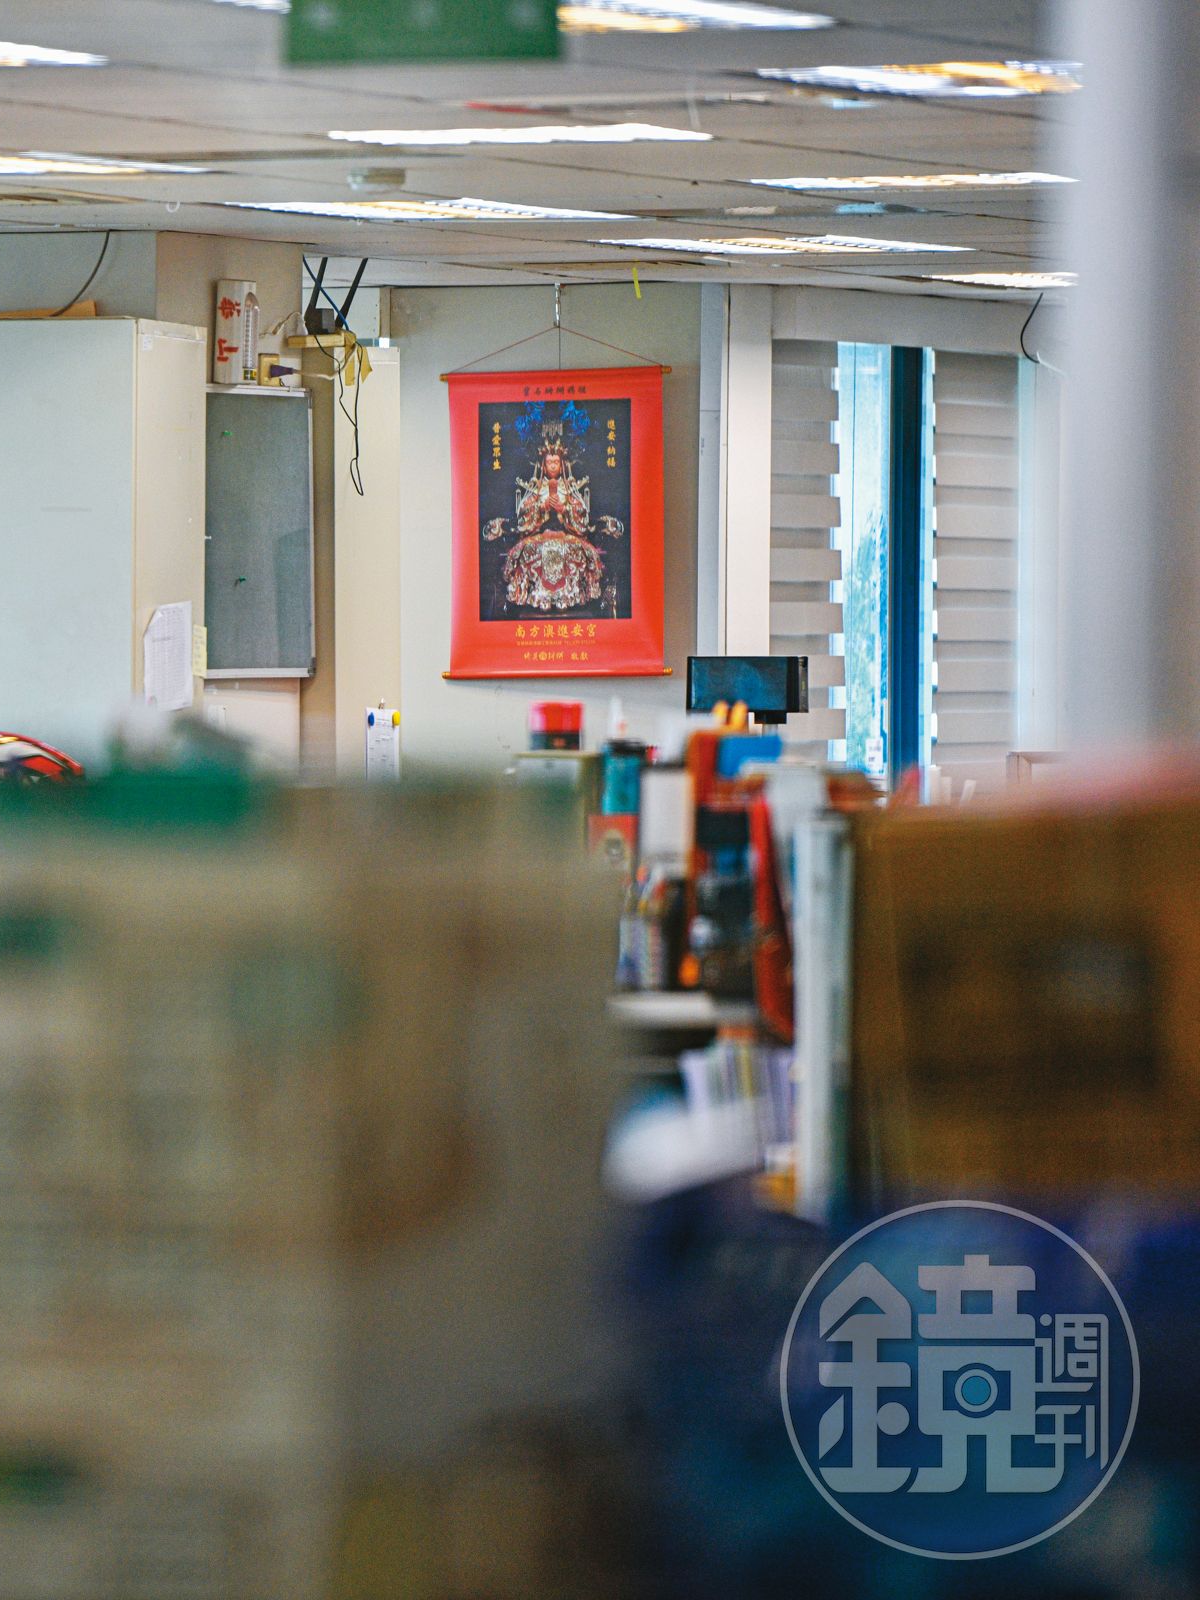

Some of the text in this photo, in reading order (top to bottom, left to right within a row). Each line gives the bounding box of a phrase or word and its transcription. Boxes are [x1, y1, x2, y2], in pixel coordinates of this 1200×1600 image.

[516, 623, 597, 639] 南方澳進安宮
